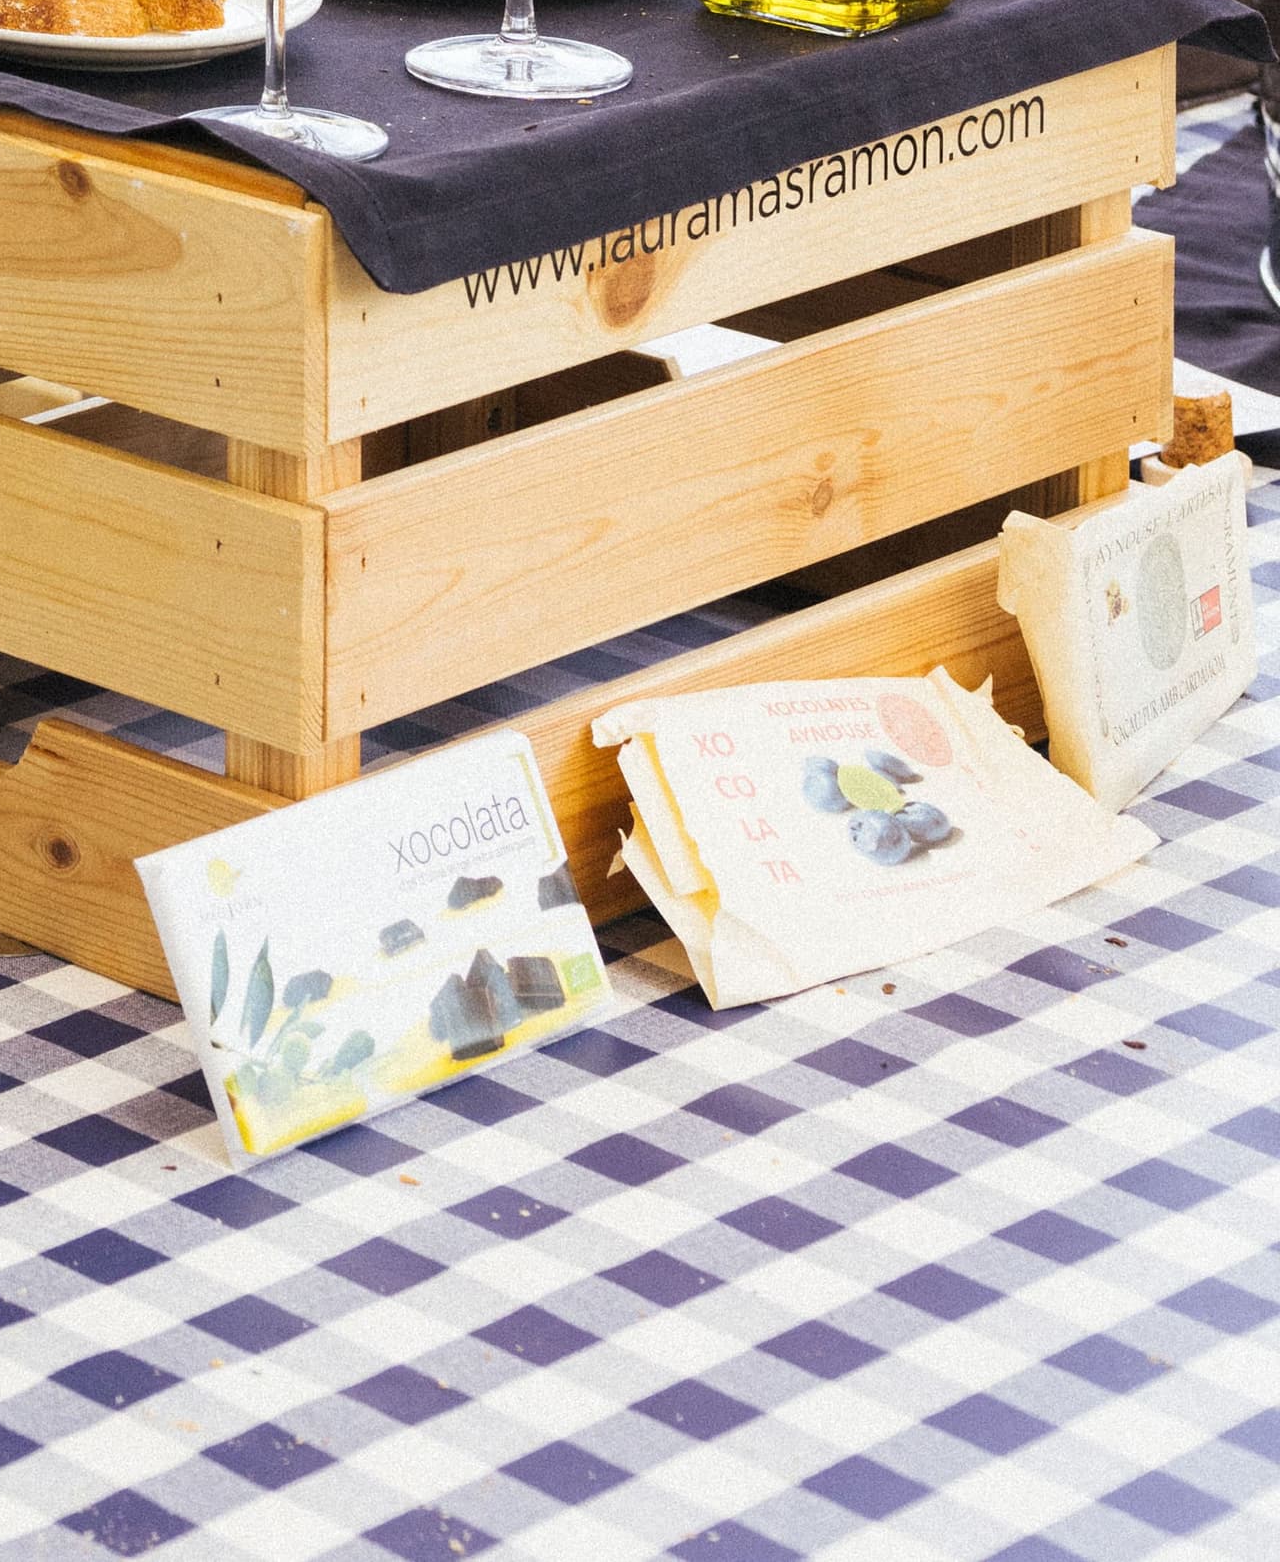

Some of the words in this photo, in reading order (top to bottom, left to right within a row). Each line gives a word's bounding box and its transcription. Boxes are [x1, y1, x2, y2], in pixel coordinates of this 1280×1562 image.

[462, 94, 1046, 309] www.lauramasramon.com
[761, 694, 870, 718] XOCOLATES
[692, 731, 736, 760] XO
[787, 720, 880, 745] AYNOUSE
[714, 773, 757, 801] CO
[386, 794, 530, 875] xocolata
[739, 816, 780, 842] LA
[760, 859, 800, 886] TA
